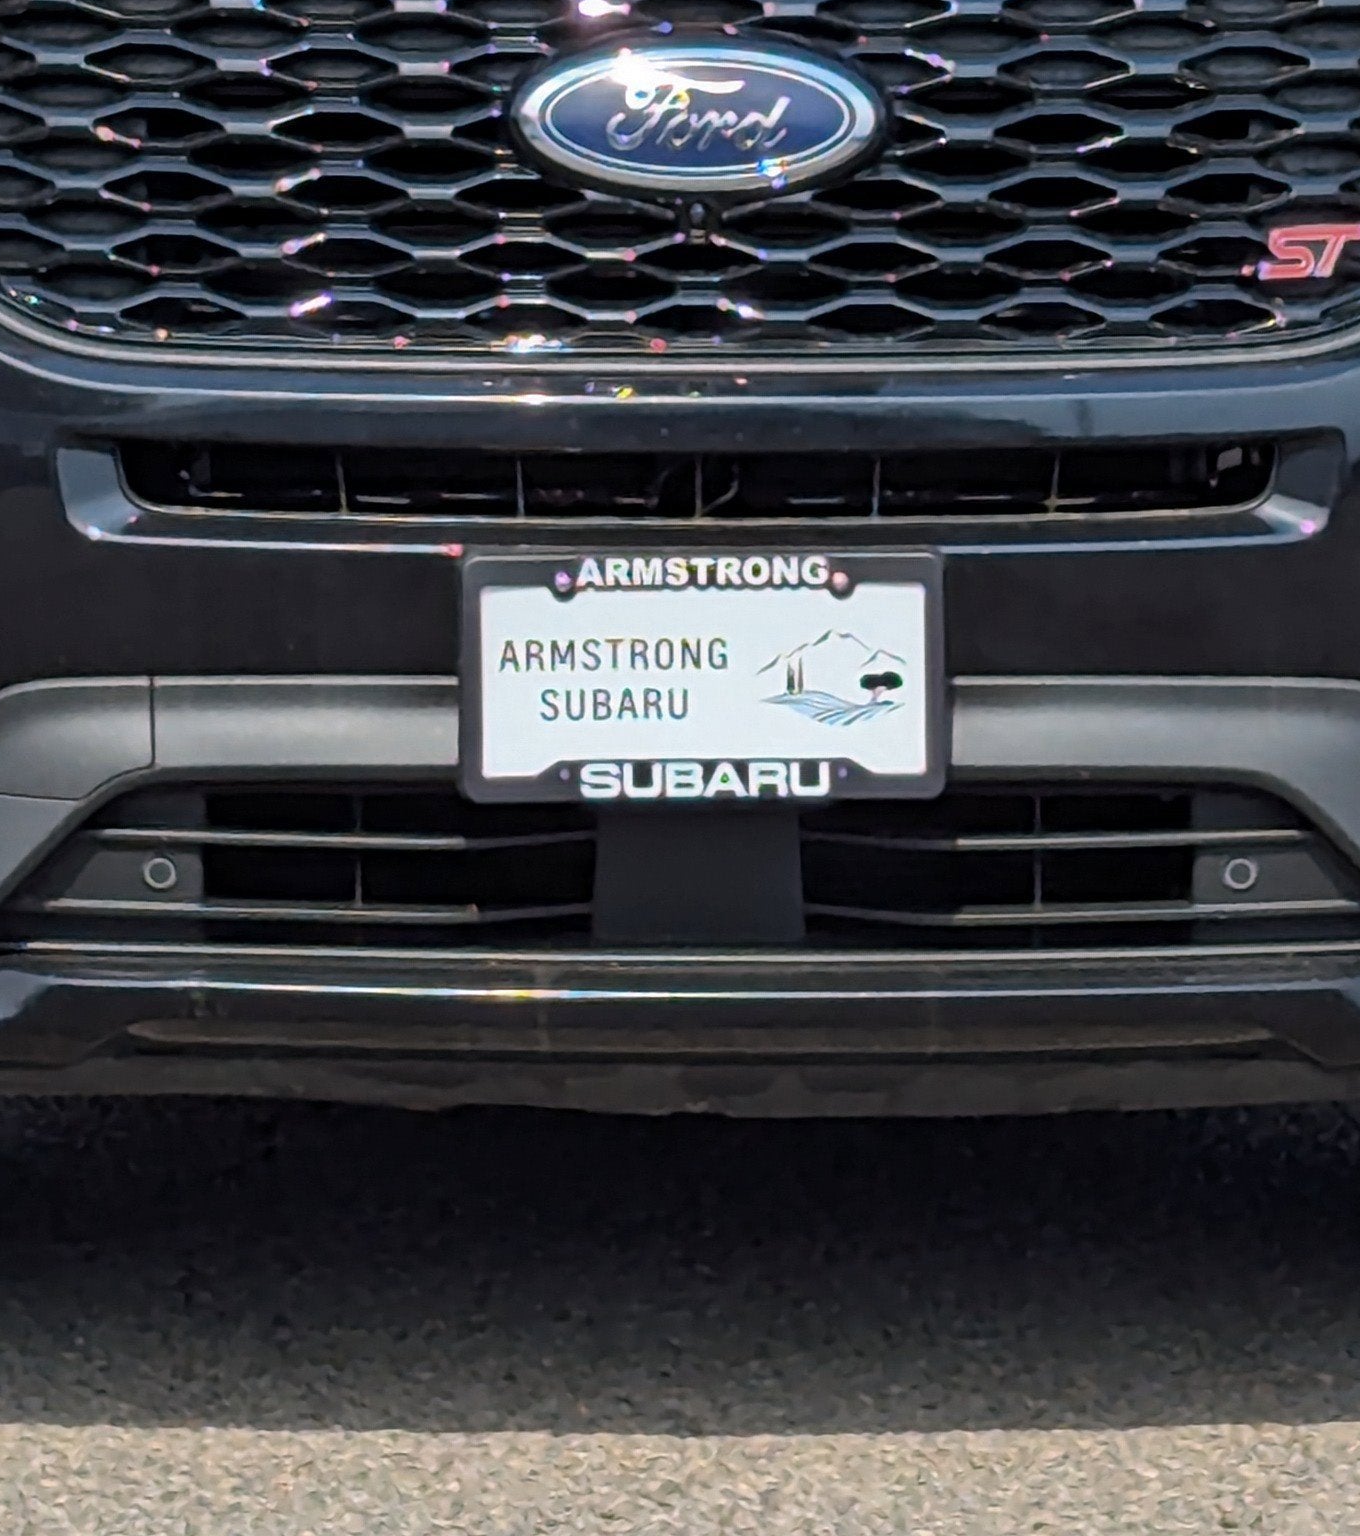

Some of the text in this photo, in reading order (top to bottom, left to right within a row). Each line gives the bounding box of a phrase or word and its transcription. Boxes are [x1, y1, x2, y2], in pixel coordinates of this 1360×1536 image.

[607, 66, 790, 151] Ford
[576, 557, 829, 587] ARMSTRONG
[499, 639, 729, 672] ARMSTRONG
[540, 689, 690, 722] SUBARU
[580, 762, 830, 799] SUBARU
